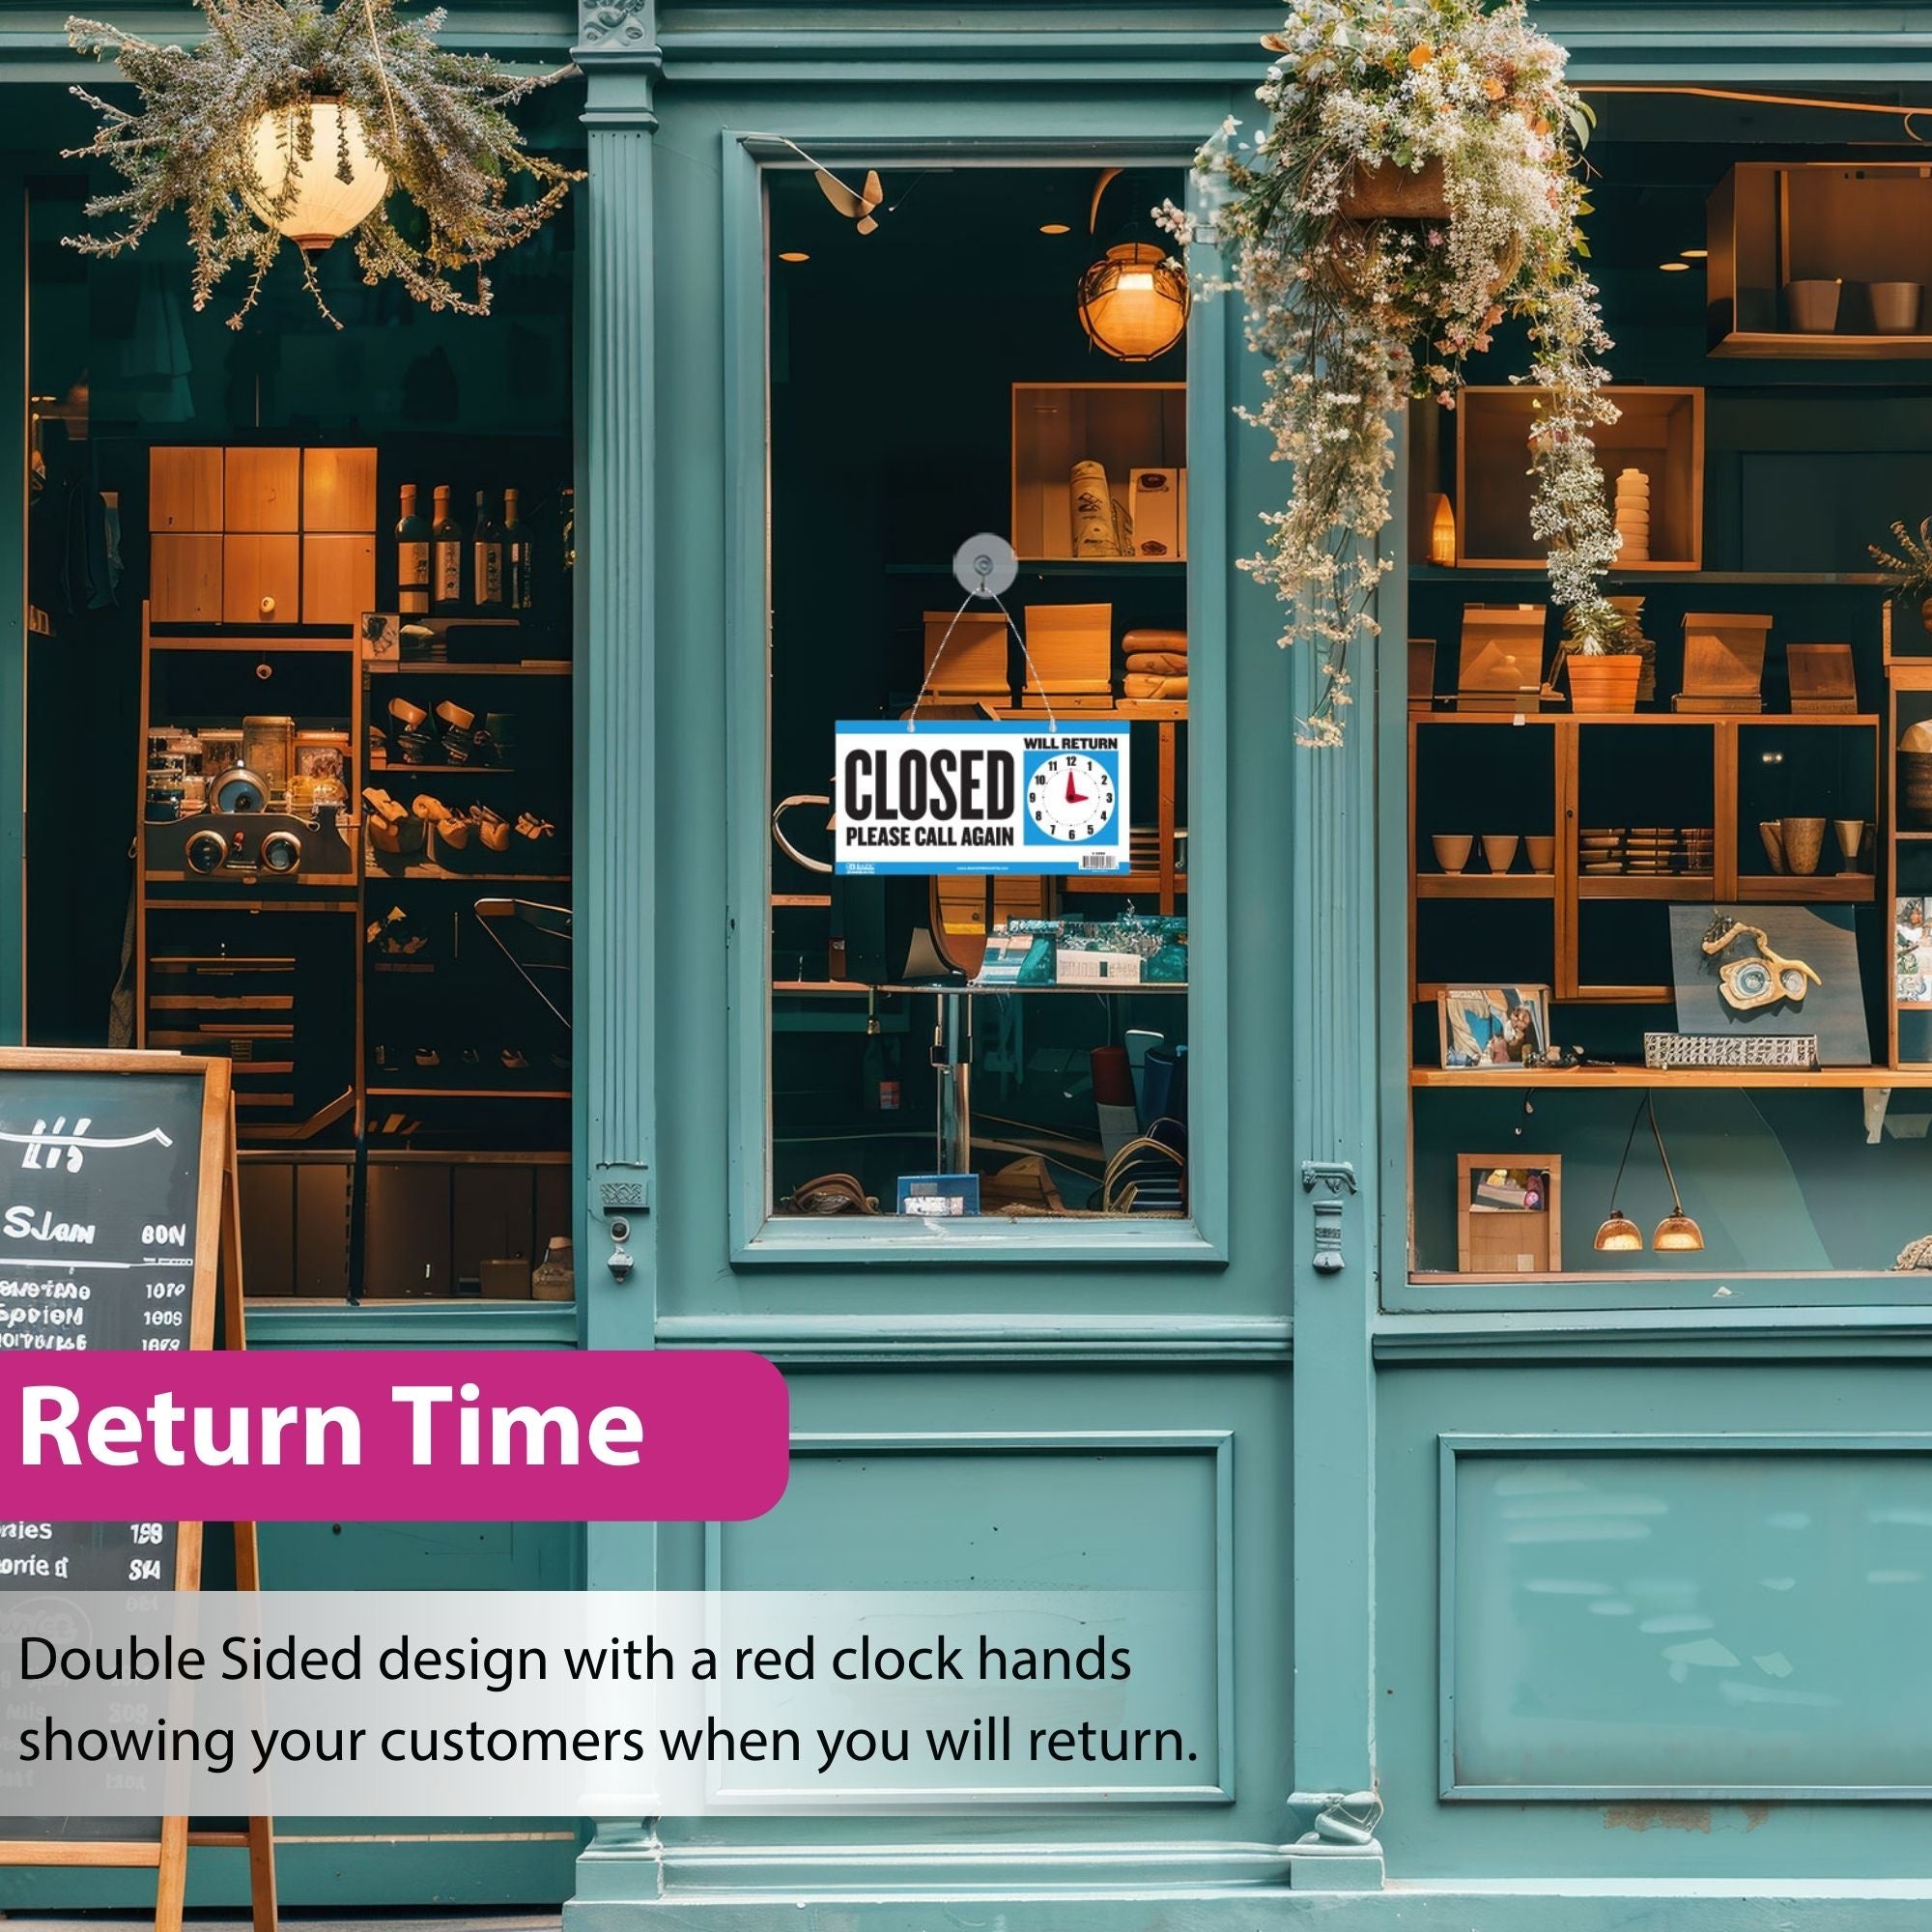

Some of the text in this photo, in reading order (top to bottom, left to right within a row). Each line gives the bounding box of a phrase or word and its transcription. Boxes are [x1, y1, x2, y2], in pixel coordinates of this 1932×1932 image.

[1024, 737, 1118, 750] WILL RETURN
[1048, 760, 1058, 772] 11
[1065, 755, 1077, 767] 12
[1087, 760, 1093, 772] 1
[844, 749, 1015, 821] CLOSED
[1035, 774, 1046, 785] 10
[1101, 775, 1108, 785] 2
[1029, 792, 1037, 804] 9
[1106, 792, 1113, 804] 3
[1035, 810, 1042, 821] 8
[1100, 810, 1107, 821] 4
[1050, 824, 1056, 836] 7
[1068, 829, 1076, 840] 6
[1087, 824, 1094, 836] 5
[846, 826, 1014, 847] PLEASE CALL AGAIN
